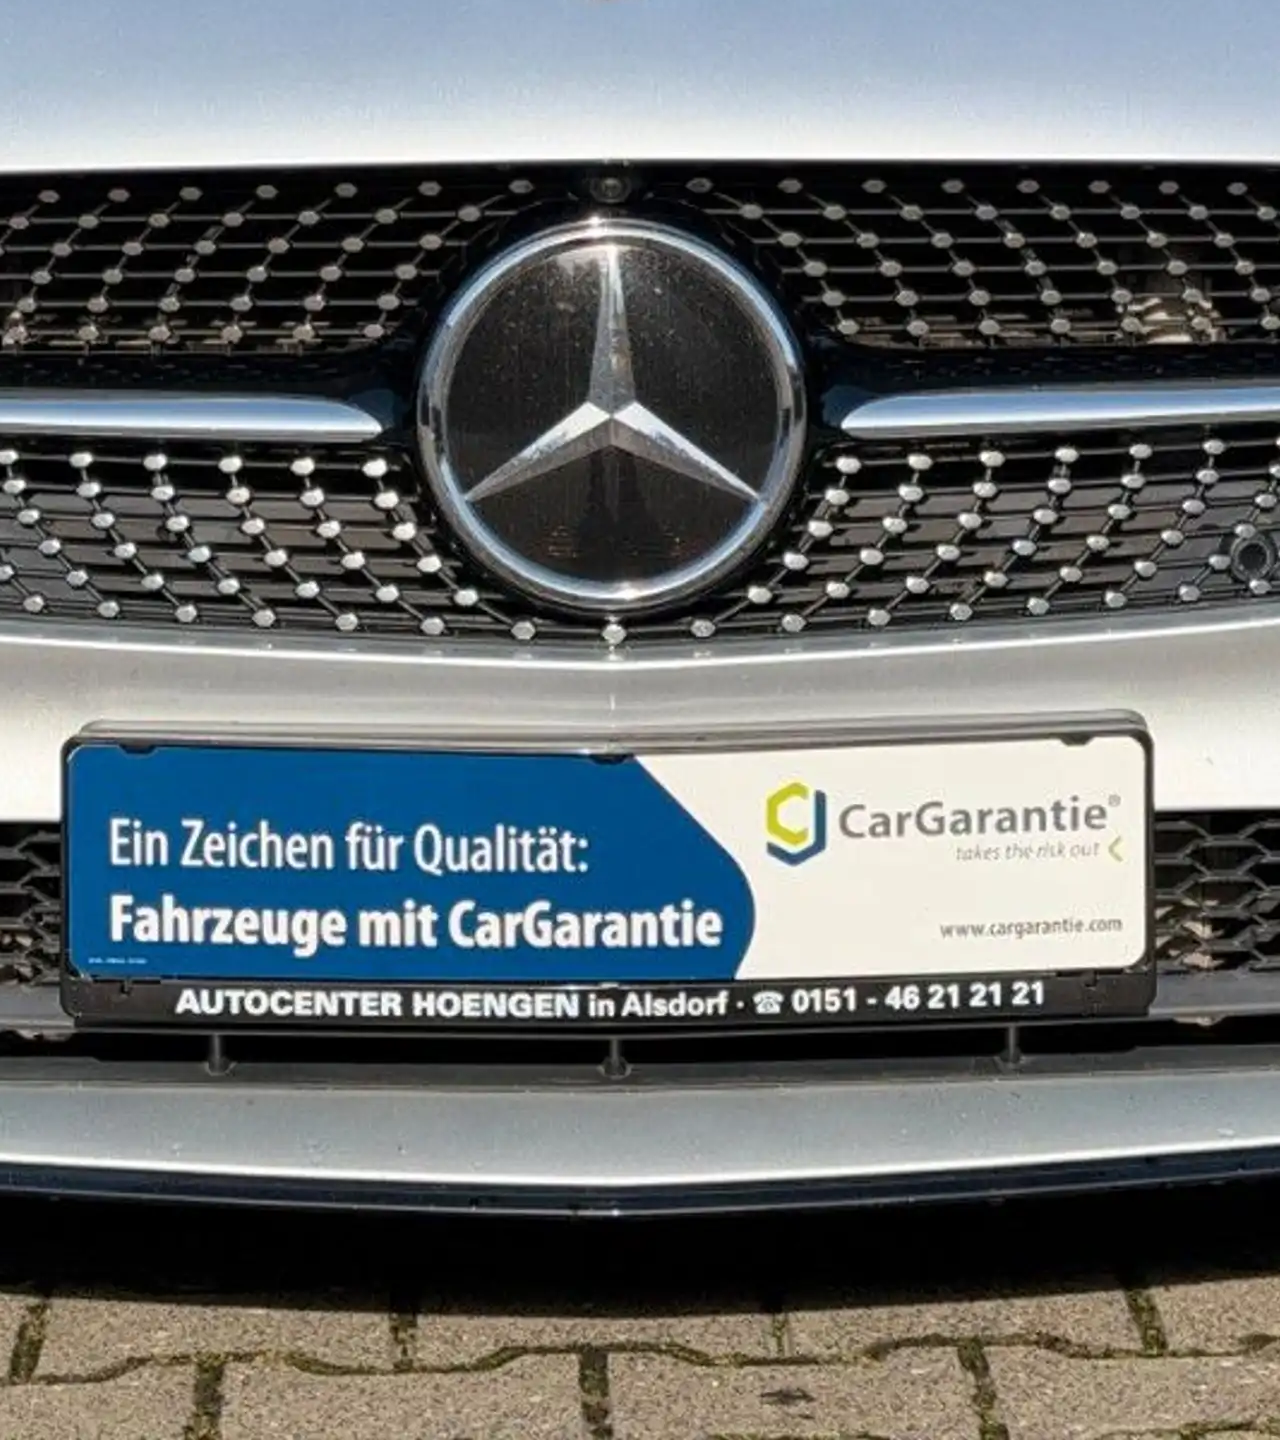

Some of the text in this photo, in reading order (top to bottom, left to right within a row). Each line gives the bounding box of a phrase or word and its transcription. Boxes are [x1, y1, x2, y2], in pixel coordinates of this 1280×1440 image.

[109, 817, 589, 876] Ein Zeichen für Qualität:
[956, 843, 1001, 861] takes
[1035, 840, 1066, 859] risk
[1069, 841, 1100, 859] out
[109, 893, 724, 959] Fahrzeuge mit CarGarantie
[939, 916, 1124, 940] www.cargarantie.com
[175, 988, 403, 1018] AUTOCENTER
[412, 990, 580, 1019] HOENGEN
[587, 992, 616, 1018] in
[620, 990, 730, 1018] Alsdorf
[790, 988, 858, 1014] 0151
[884, 984, 921, 1010] 46
[926, 983, 961, 1009] 21
[968, 981, 1003, 1007] 21
[1010, 979, 1045, 1006] 21
